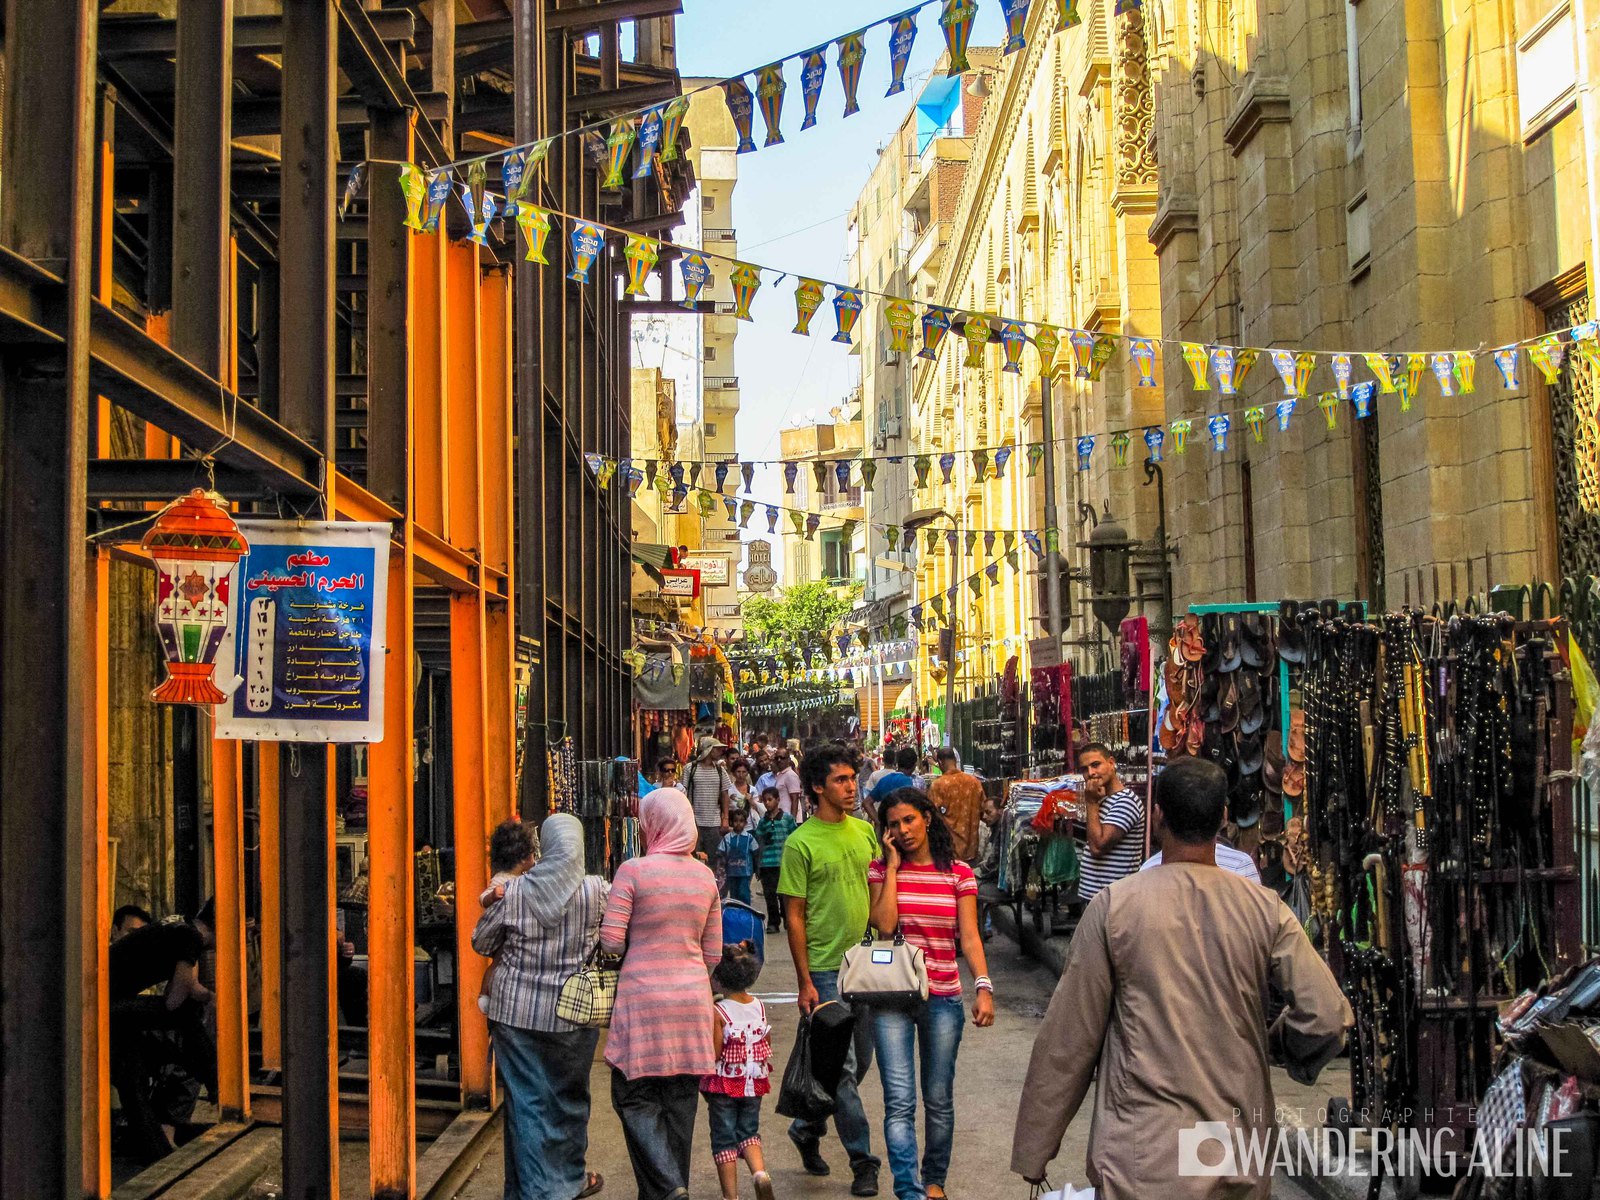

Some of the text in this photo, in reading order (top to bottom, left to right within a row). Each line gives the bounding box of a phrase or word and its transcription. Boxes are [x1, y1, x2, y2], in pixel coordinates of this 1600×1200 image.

[578, 236, 598, 246] محمد
[686, 264, 704, 274] محمد
[800, 292, 820, 302] محمد
[891, 310, 910, 320] محمد
[286, 550, 330, 570] مطعم
[318, 573, 364, 592] الحرم
[290, 599, 336, 610] مشوية
[338, 601, 364, 612] فرخة
[322, 614, 350, 625] فرخة
[317, 629, 336, 638] خضار
[338, 630, 362, 639] طاجن
[300, 645, 361, 653] واحد
[286, 657, 316, 665] سادة
[316, 658, 360, 666] خضار
[257, 671, 263, 680] ٦
[286, 670, 318, 680] فراخ
[286, 686, 360, 695] مشروب
[284, 700, 310, 709] فرن
[313, 700, 362, 710] مكرونة
